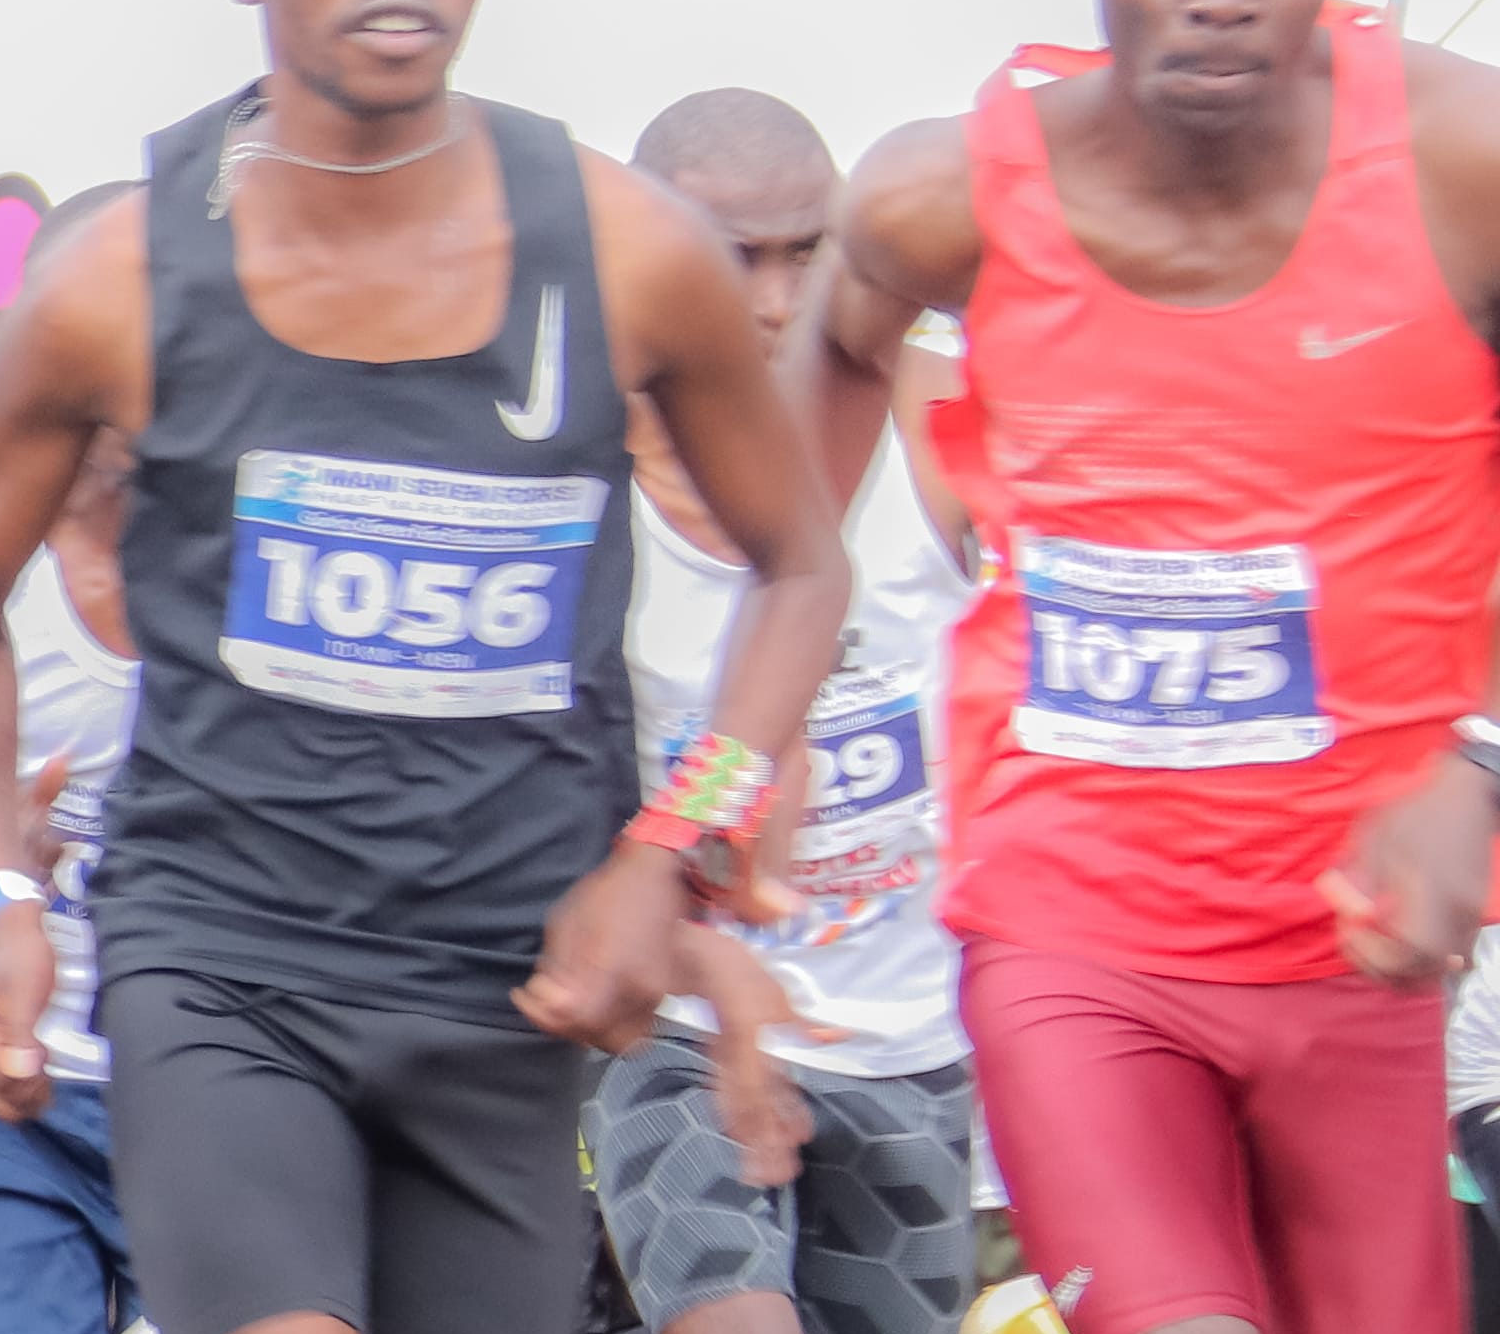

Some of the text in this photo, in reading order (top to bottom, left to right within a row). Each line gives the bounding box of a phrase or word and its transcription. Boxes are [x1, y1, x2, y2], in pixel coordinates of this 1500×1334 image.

[257, 536, 559, 648] 1056
[1032, 610, 1292, 706] 1075
[803, 732, 905, 809] 29
